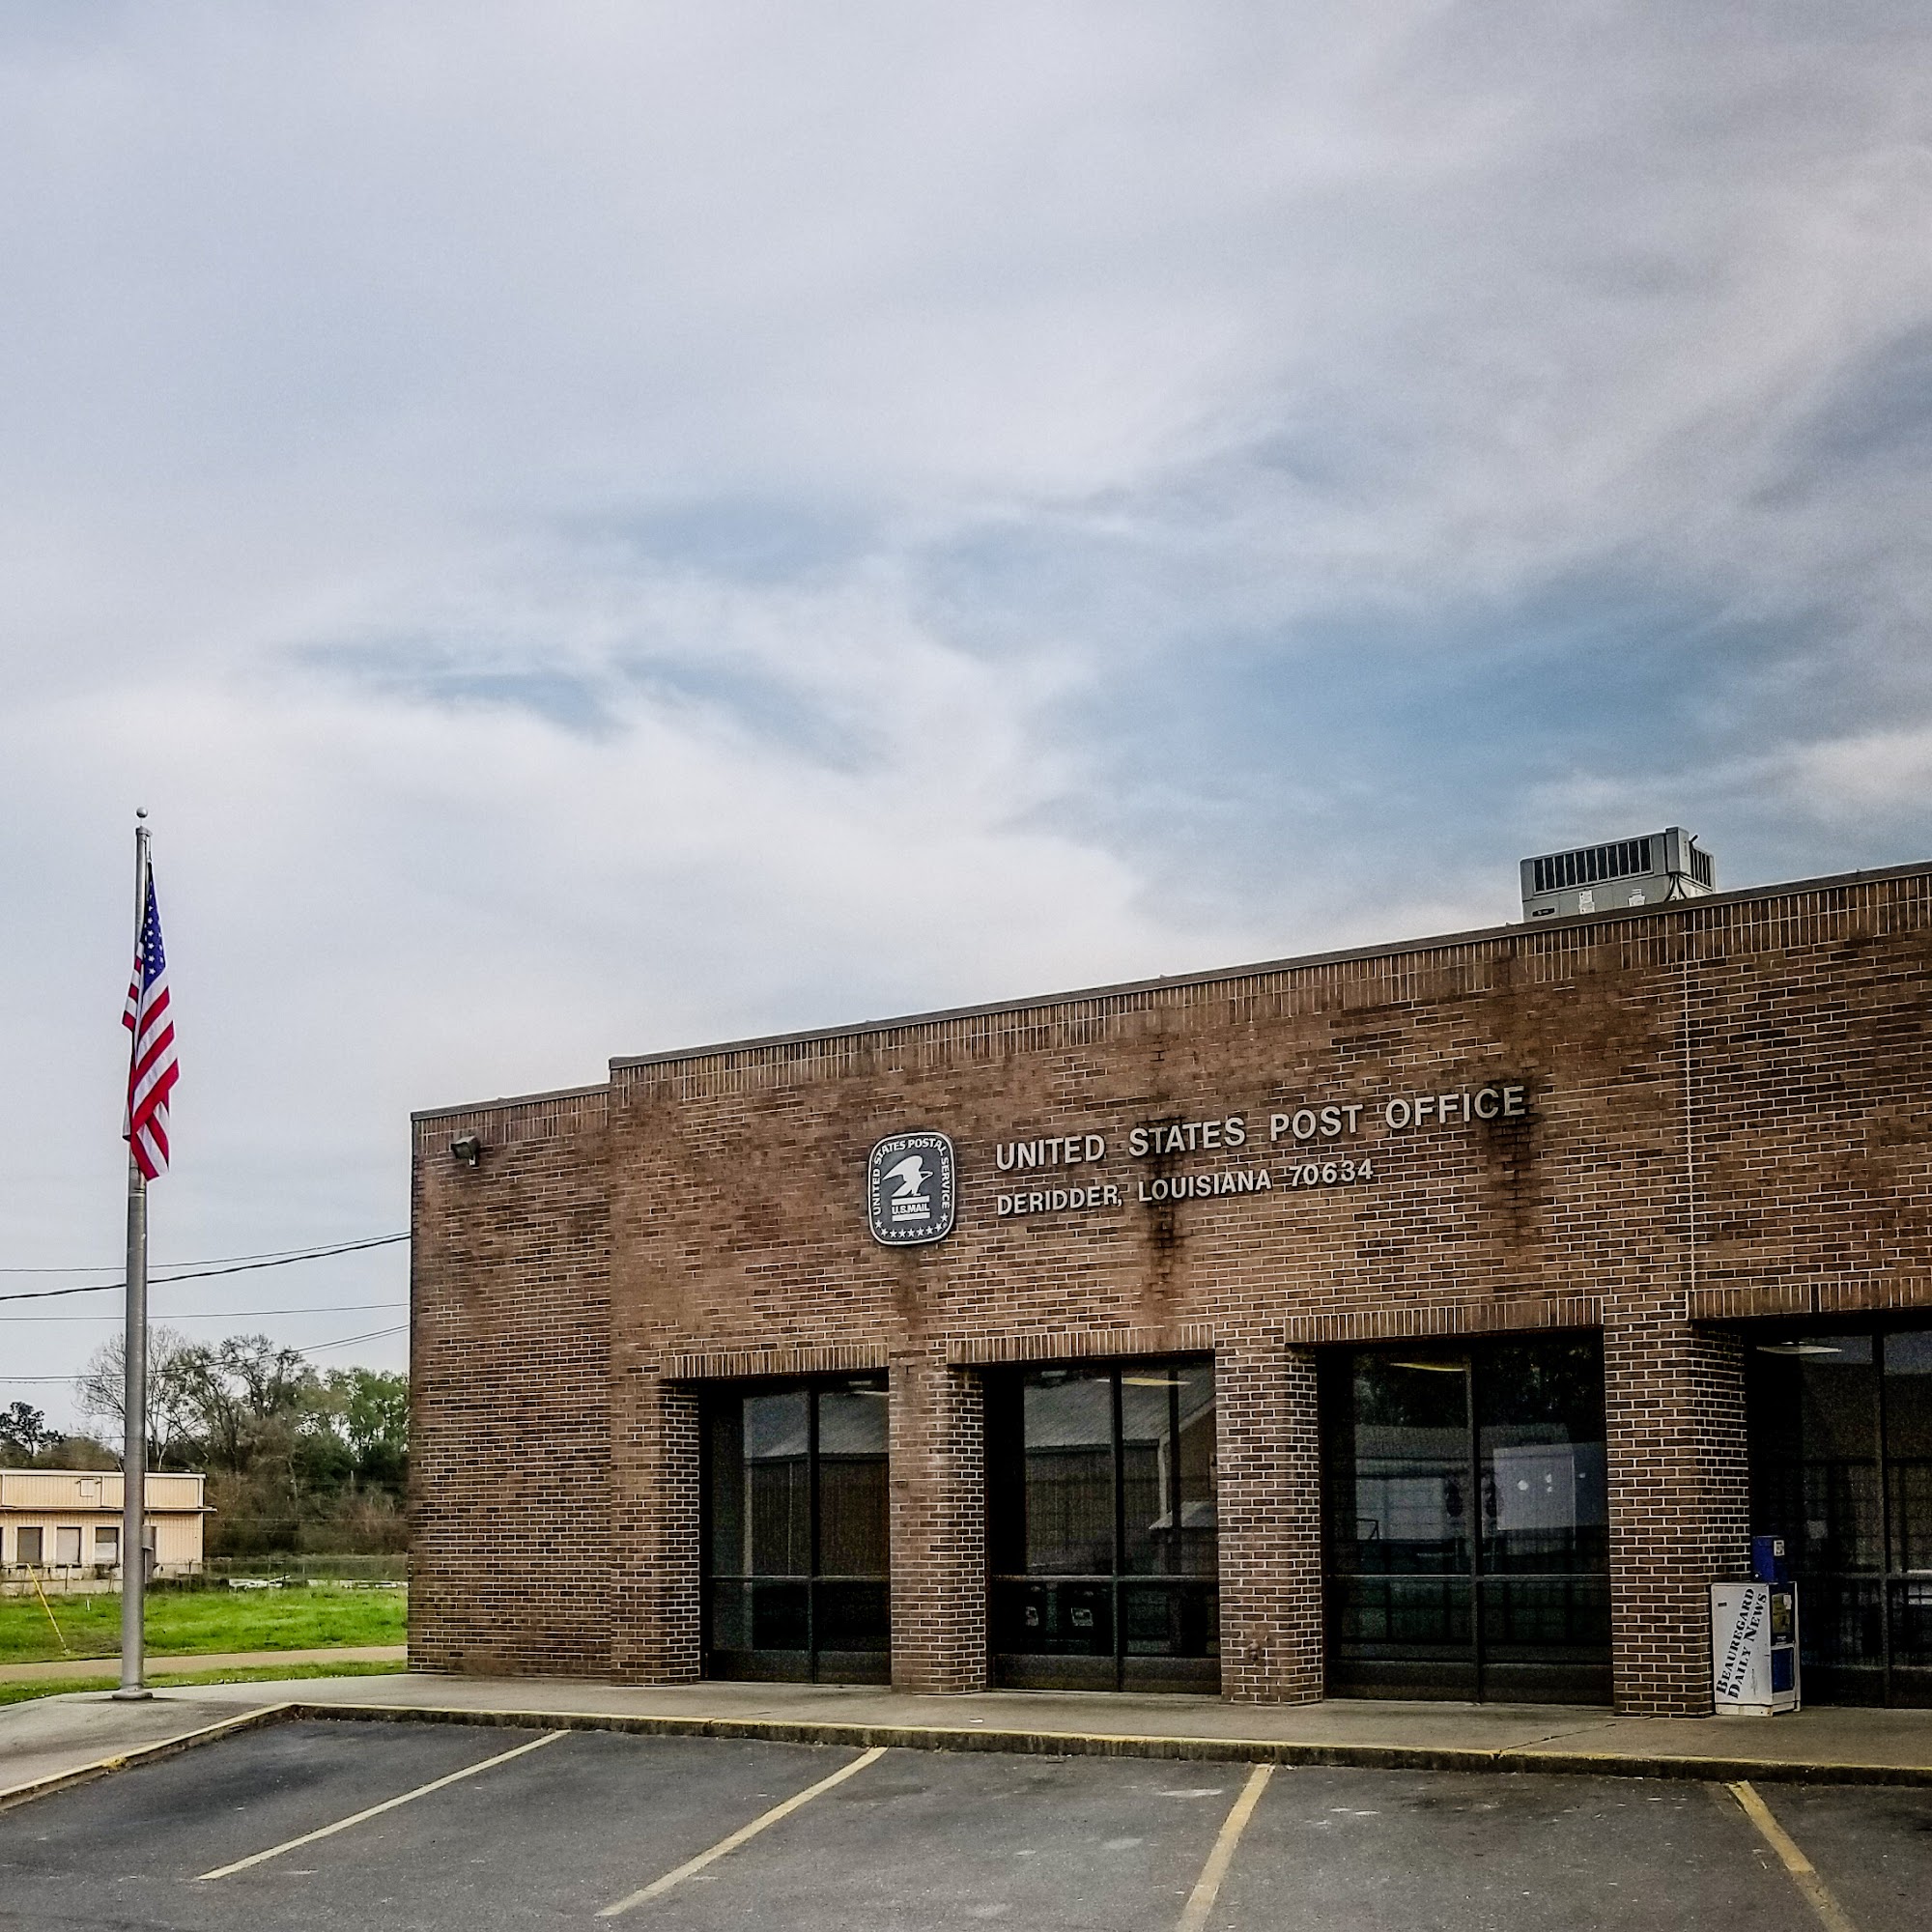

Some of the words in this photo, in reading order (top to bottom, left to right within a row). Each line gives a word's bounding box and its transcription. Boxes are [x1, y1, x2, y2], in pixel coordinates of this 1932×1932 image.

[873, 1140, 906, 1166] STATES
[907, 1137, 947, 1156] POSTAL
[996, 1134, 1105, 1171] UNITED
[1128, 1117, 1246, 1157] STATES
[1270, 1103, 1363, 1142] POST
[1385, 1085, 1525, 1129] OFFICE
[872, 1168, 882, 1216] UNITED
[940, 1157, 951, 1209] SERVICE
[997, 1183, 1122, 1216] DERIDDER,
[1138, 1169, 1272, 1203] LOUISIANA
[1289, 1158, 1374, 1187] 70634
[1716, 1588, 1754, 1694] BEAUREGARD
[1727, 1646, 1752, 1699] DAILY
[1744, 1593, 1767, 1642] NEWS
